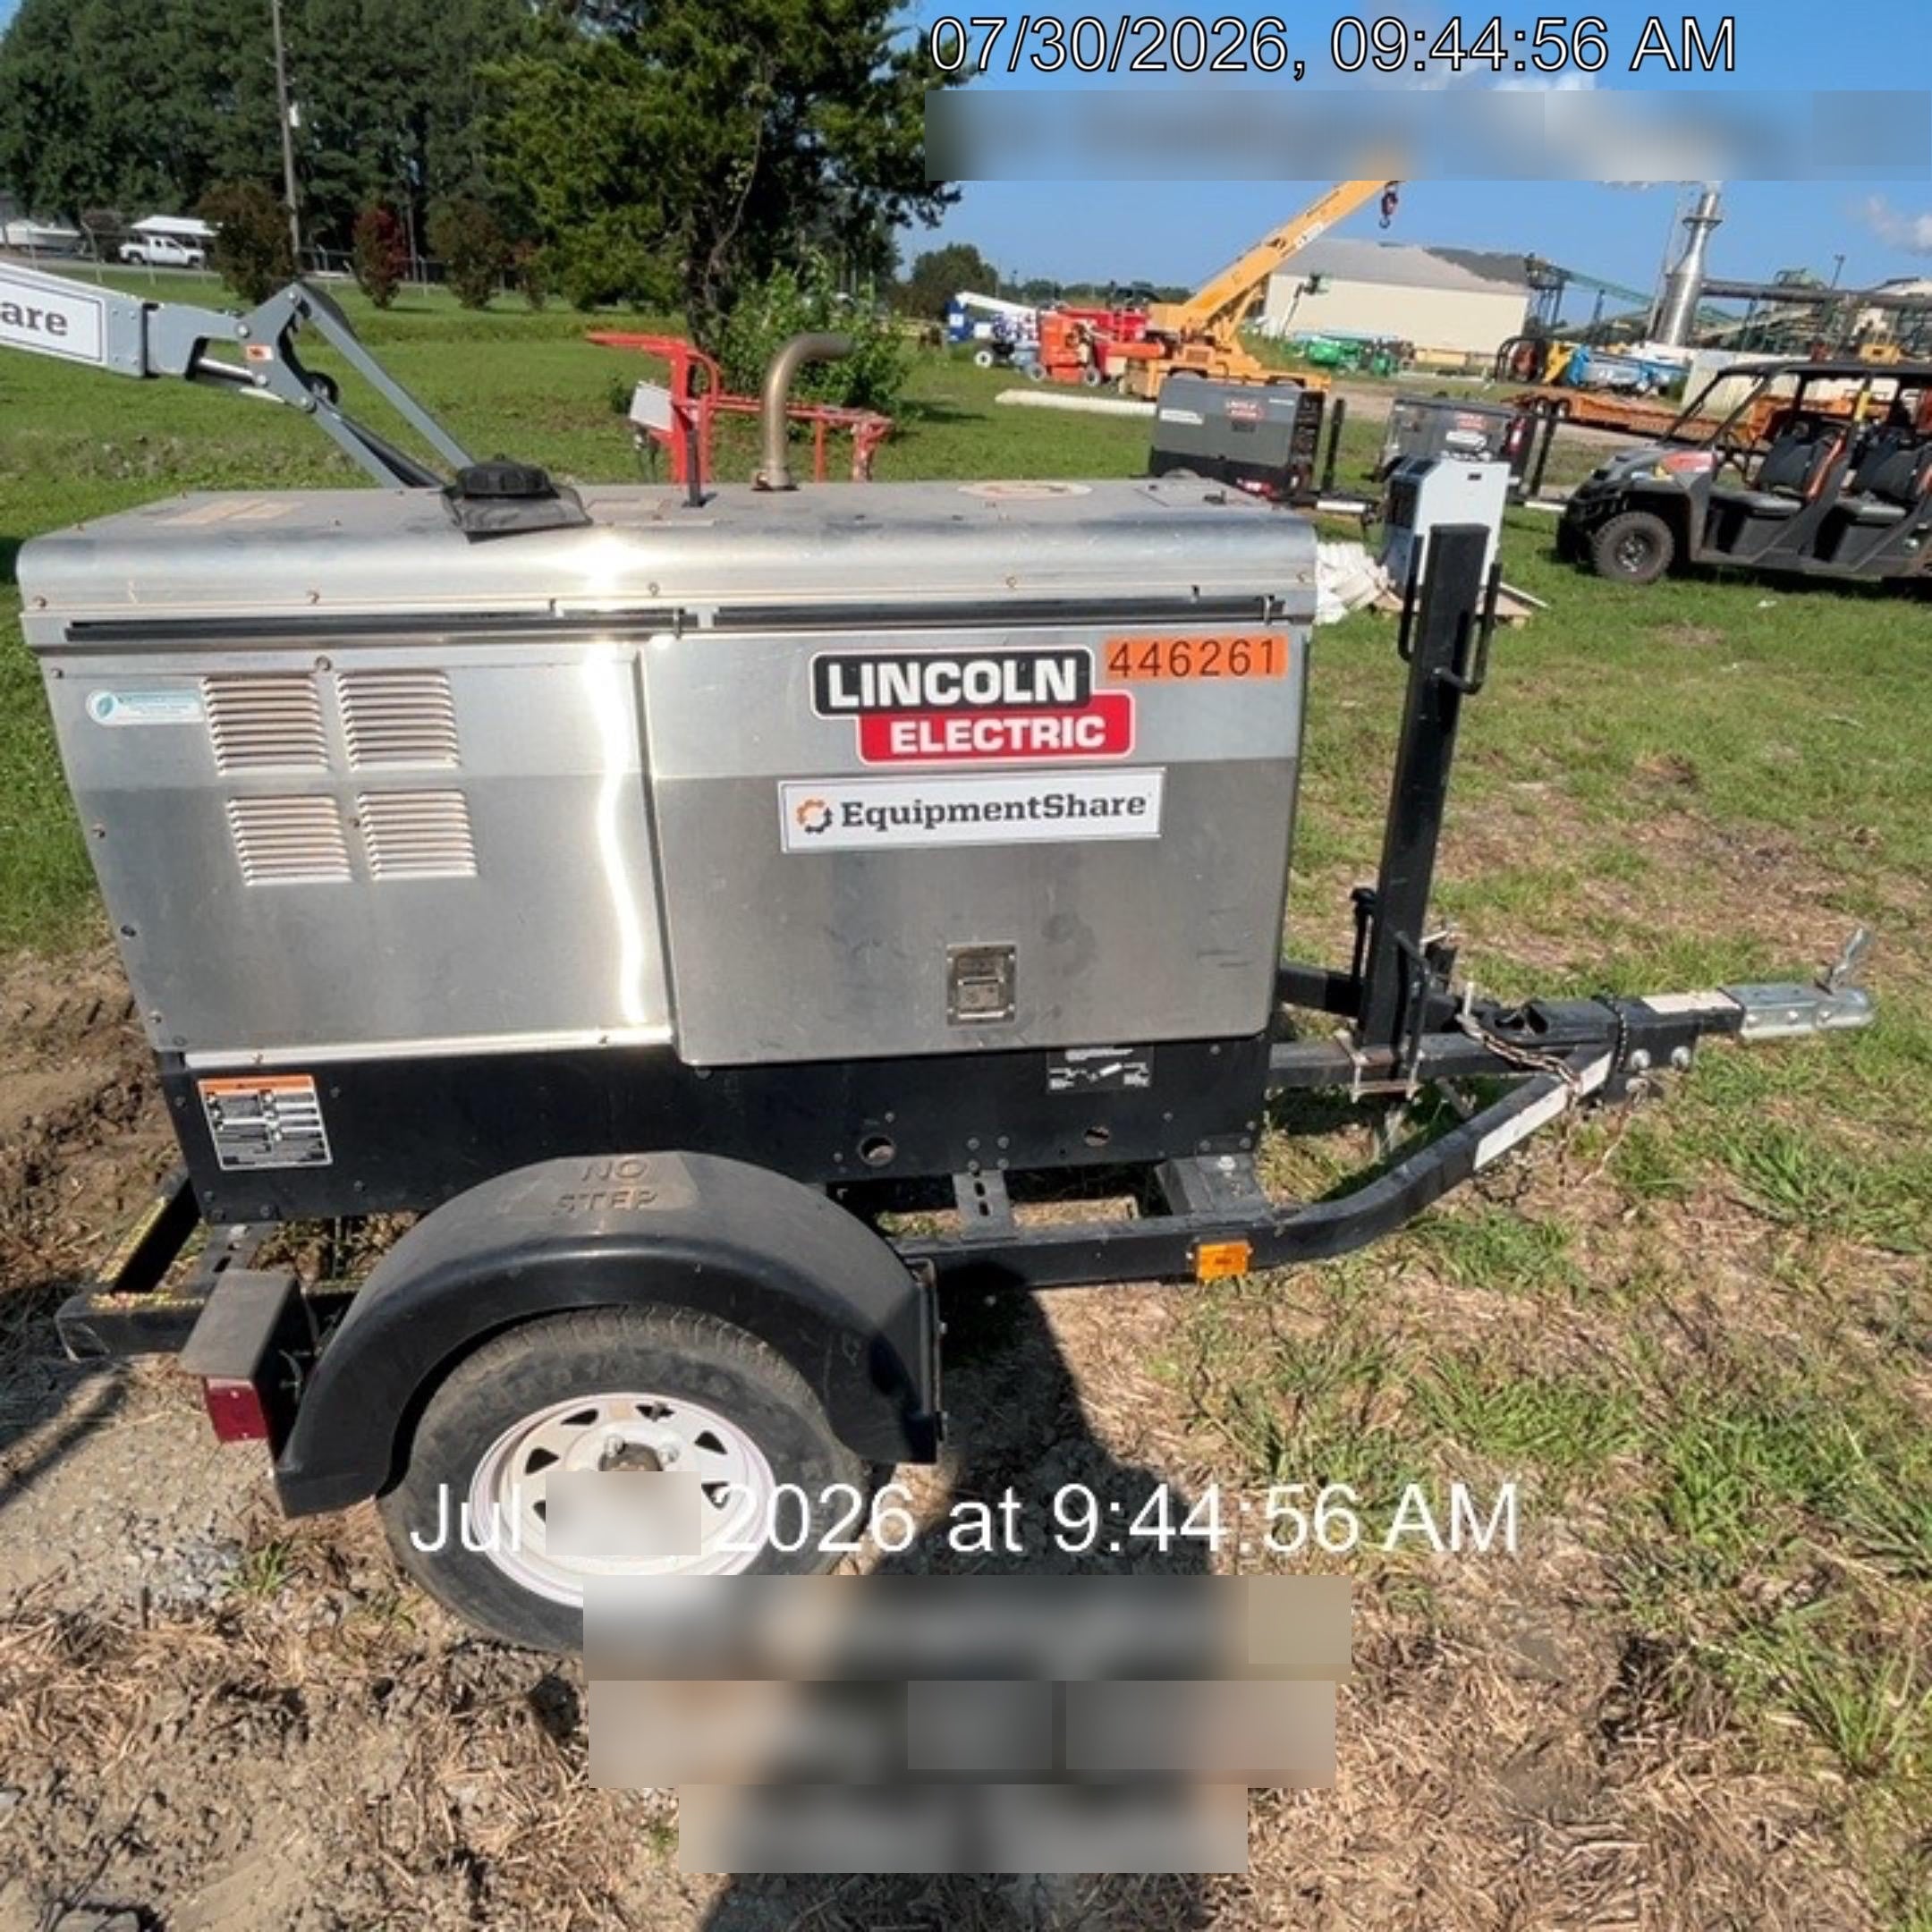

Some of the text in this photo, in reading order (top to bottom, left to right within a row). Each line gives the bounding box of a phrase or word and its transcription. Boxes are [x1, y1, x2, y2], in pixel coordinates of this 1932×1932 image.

[1107, 638, 1275, 678] 446261
[827, 658, 1077, 709] LINCOLN
[890, 716, 1106, 754] ELECTRIC
[841, 793, 1146, 832] EquipmentShare
[580, 1158, 649, 1182] NO
[554, 1190, 658, 1214] STEP
